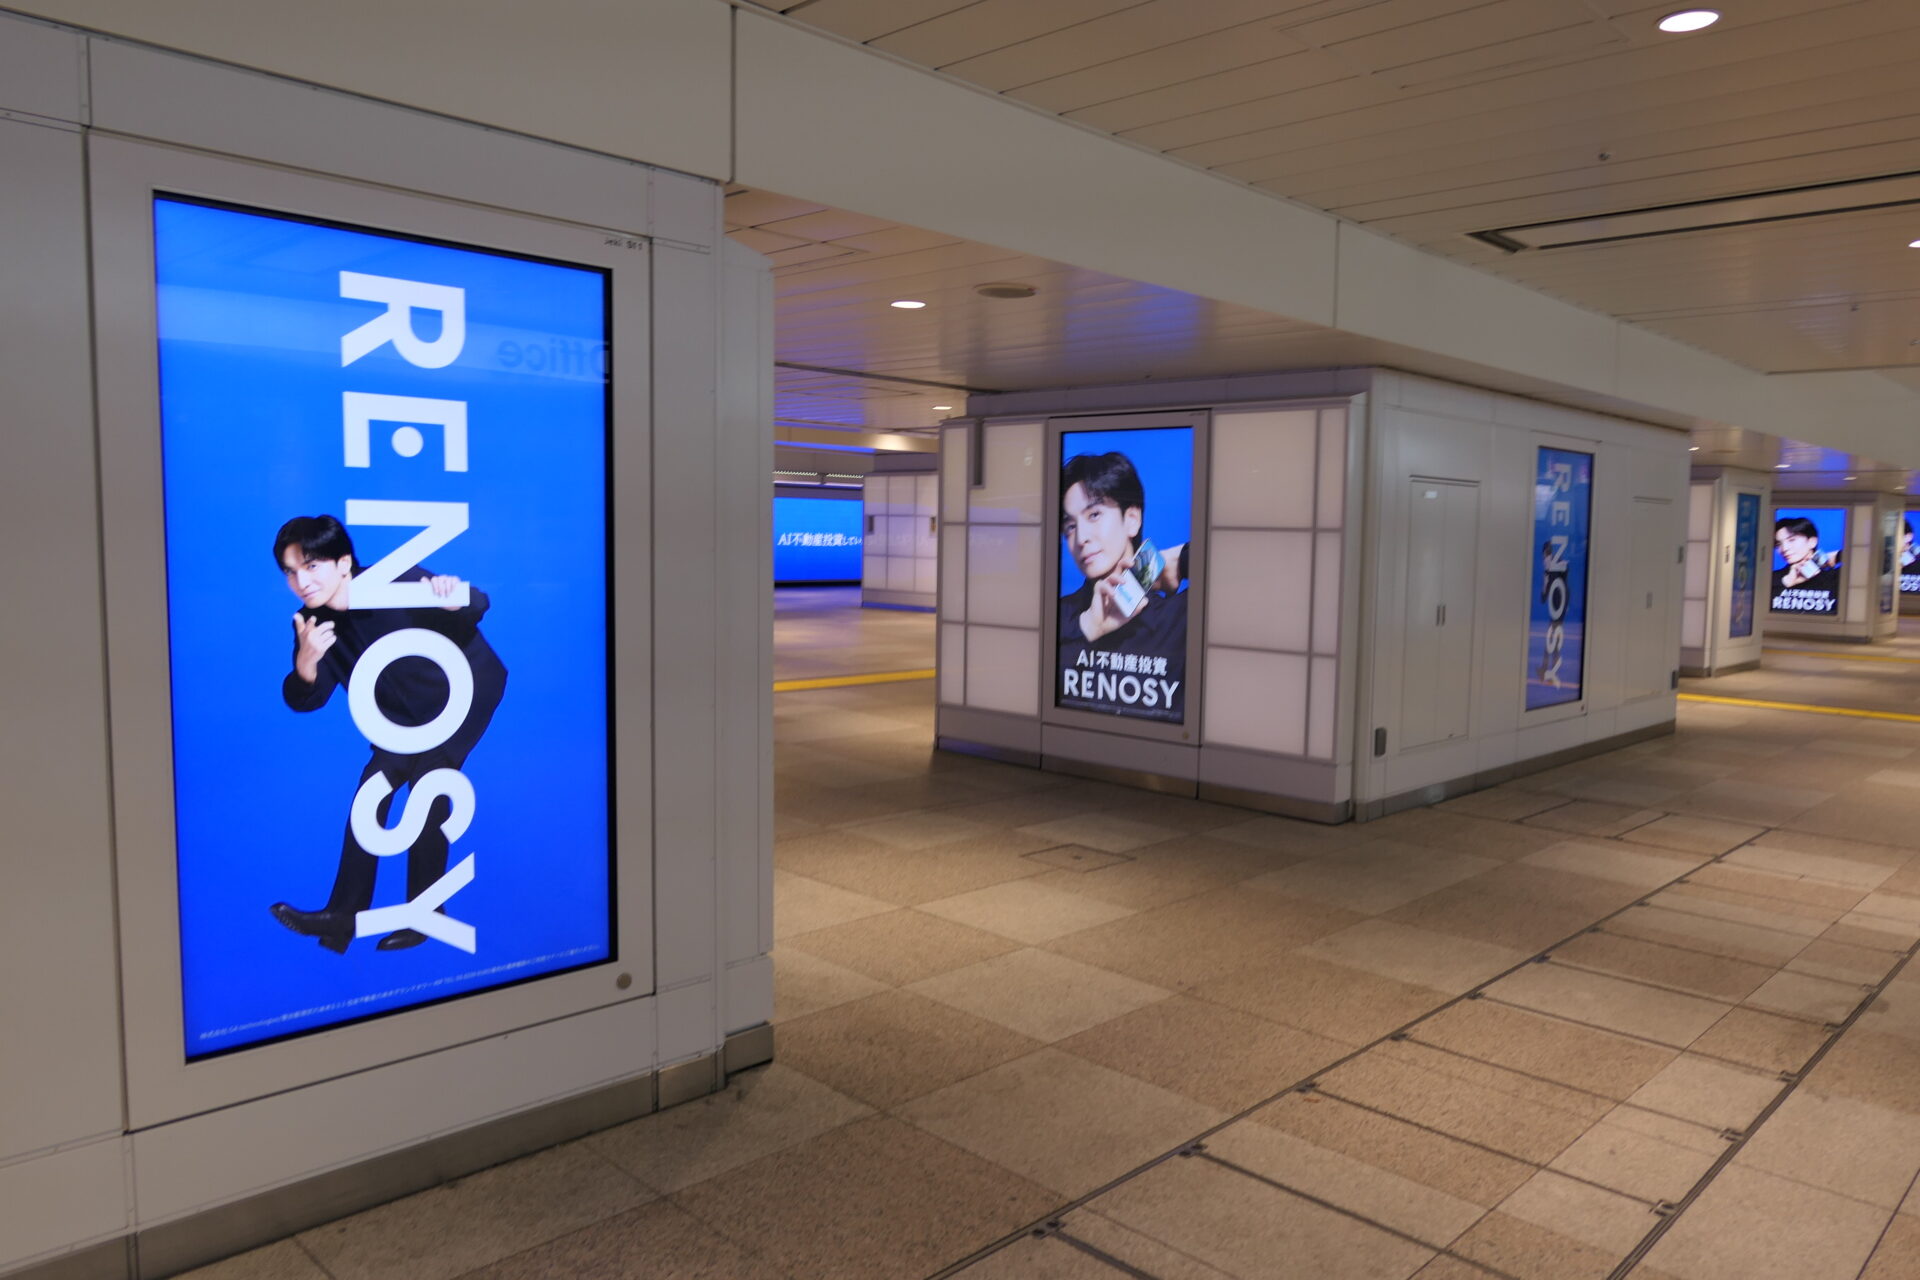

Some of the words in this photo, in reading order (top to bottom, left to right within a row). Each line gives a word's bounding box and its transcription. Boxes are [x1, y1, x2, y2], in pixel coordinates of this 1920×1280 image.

[1544, 463, 1572, 689] RENOSY
[340, 271, 476, 954] RENOSY
[1772, 596, 1836, 611] RENOSY
[1076, 649, 1168, 676] AI不動産投資
[1063, 668, 1180, 709] RENOSY
